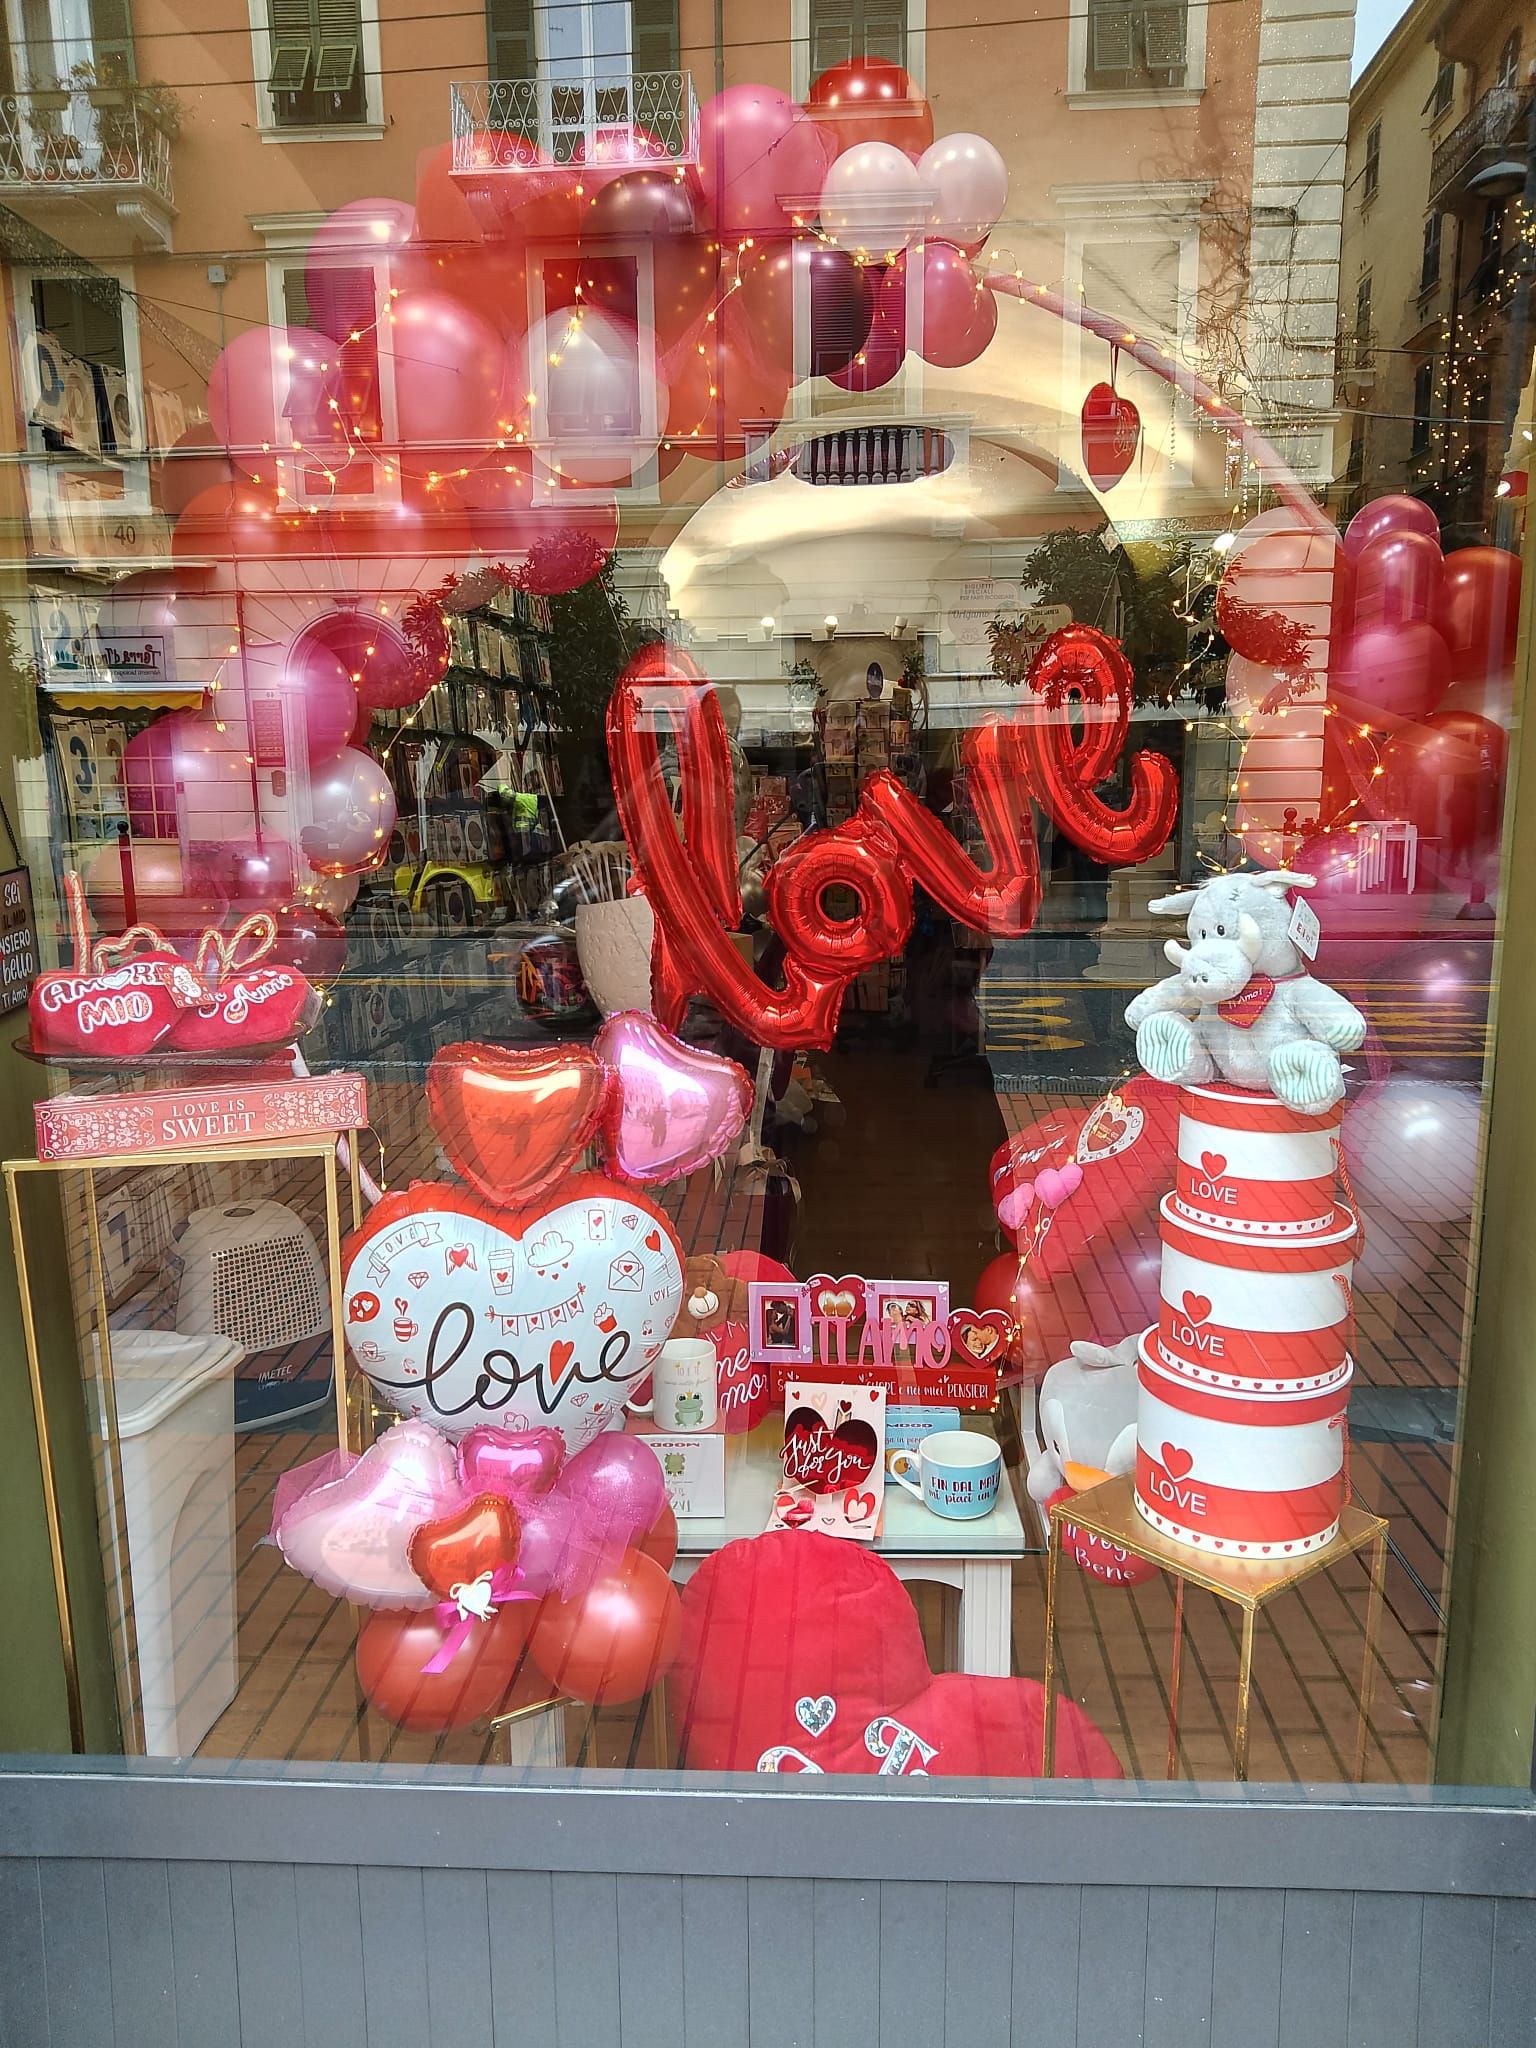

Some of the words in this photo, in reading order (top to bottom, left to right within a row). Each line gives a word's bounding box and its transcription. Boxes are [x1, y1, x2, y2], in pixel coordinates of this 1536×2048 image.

[114, 525, 136, 546] 40
[4, 881, 21, 907] sei
[2, 952, 33, 986] bello
[77, 990, 153, 1034] MIO
[172, 1101, 223, 1117] LOVE
[228, 1098, 245, 1112] IS
[162, 1111, 256, 1141] SWEET
[1190, 1177, 1238, 1206] LOVE
[811, 1317, 850, 1366] TI
[858, 1317, 952, 1369] AMO
[1171, 1319, 1226, 1358] LOVE
[360, 1301, 657, 1416] love
[258, 1364, 293, 1383] IMETEC
[947, 1383, 989, 1399] PENSIERI
[928, 1488, 940, 1500] mi
[944, 1492, 973, 1506] piaci
[952, 1480, 975, 1493] DAL
[1149, 1471, 1208, 1517] LOVE
[1074, 1546, 1137, 1580] Bene
